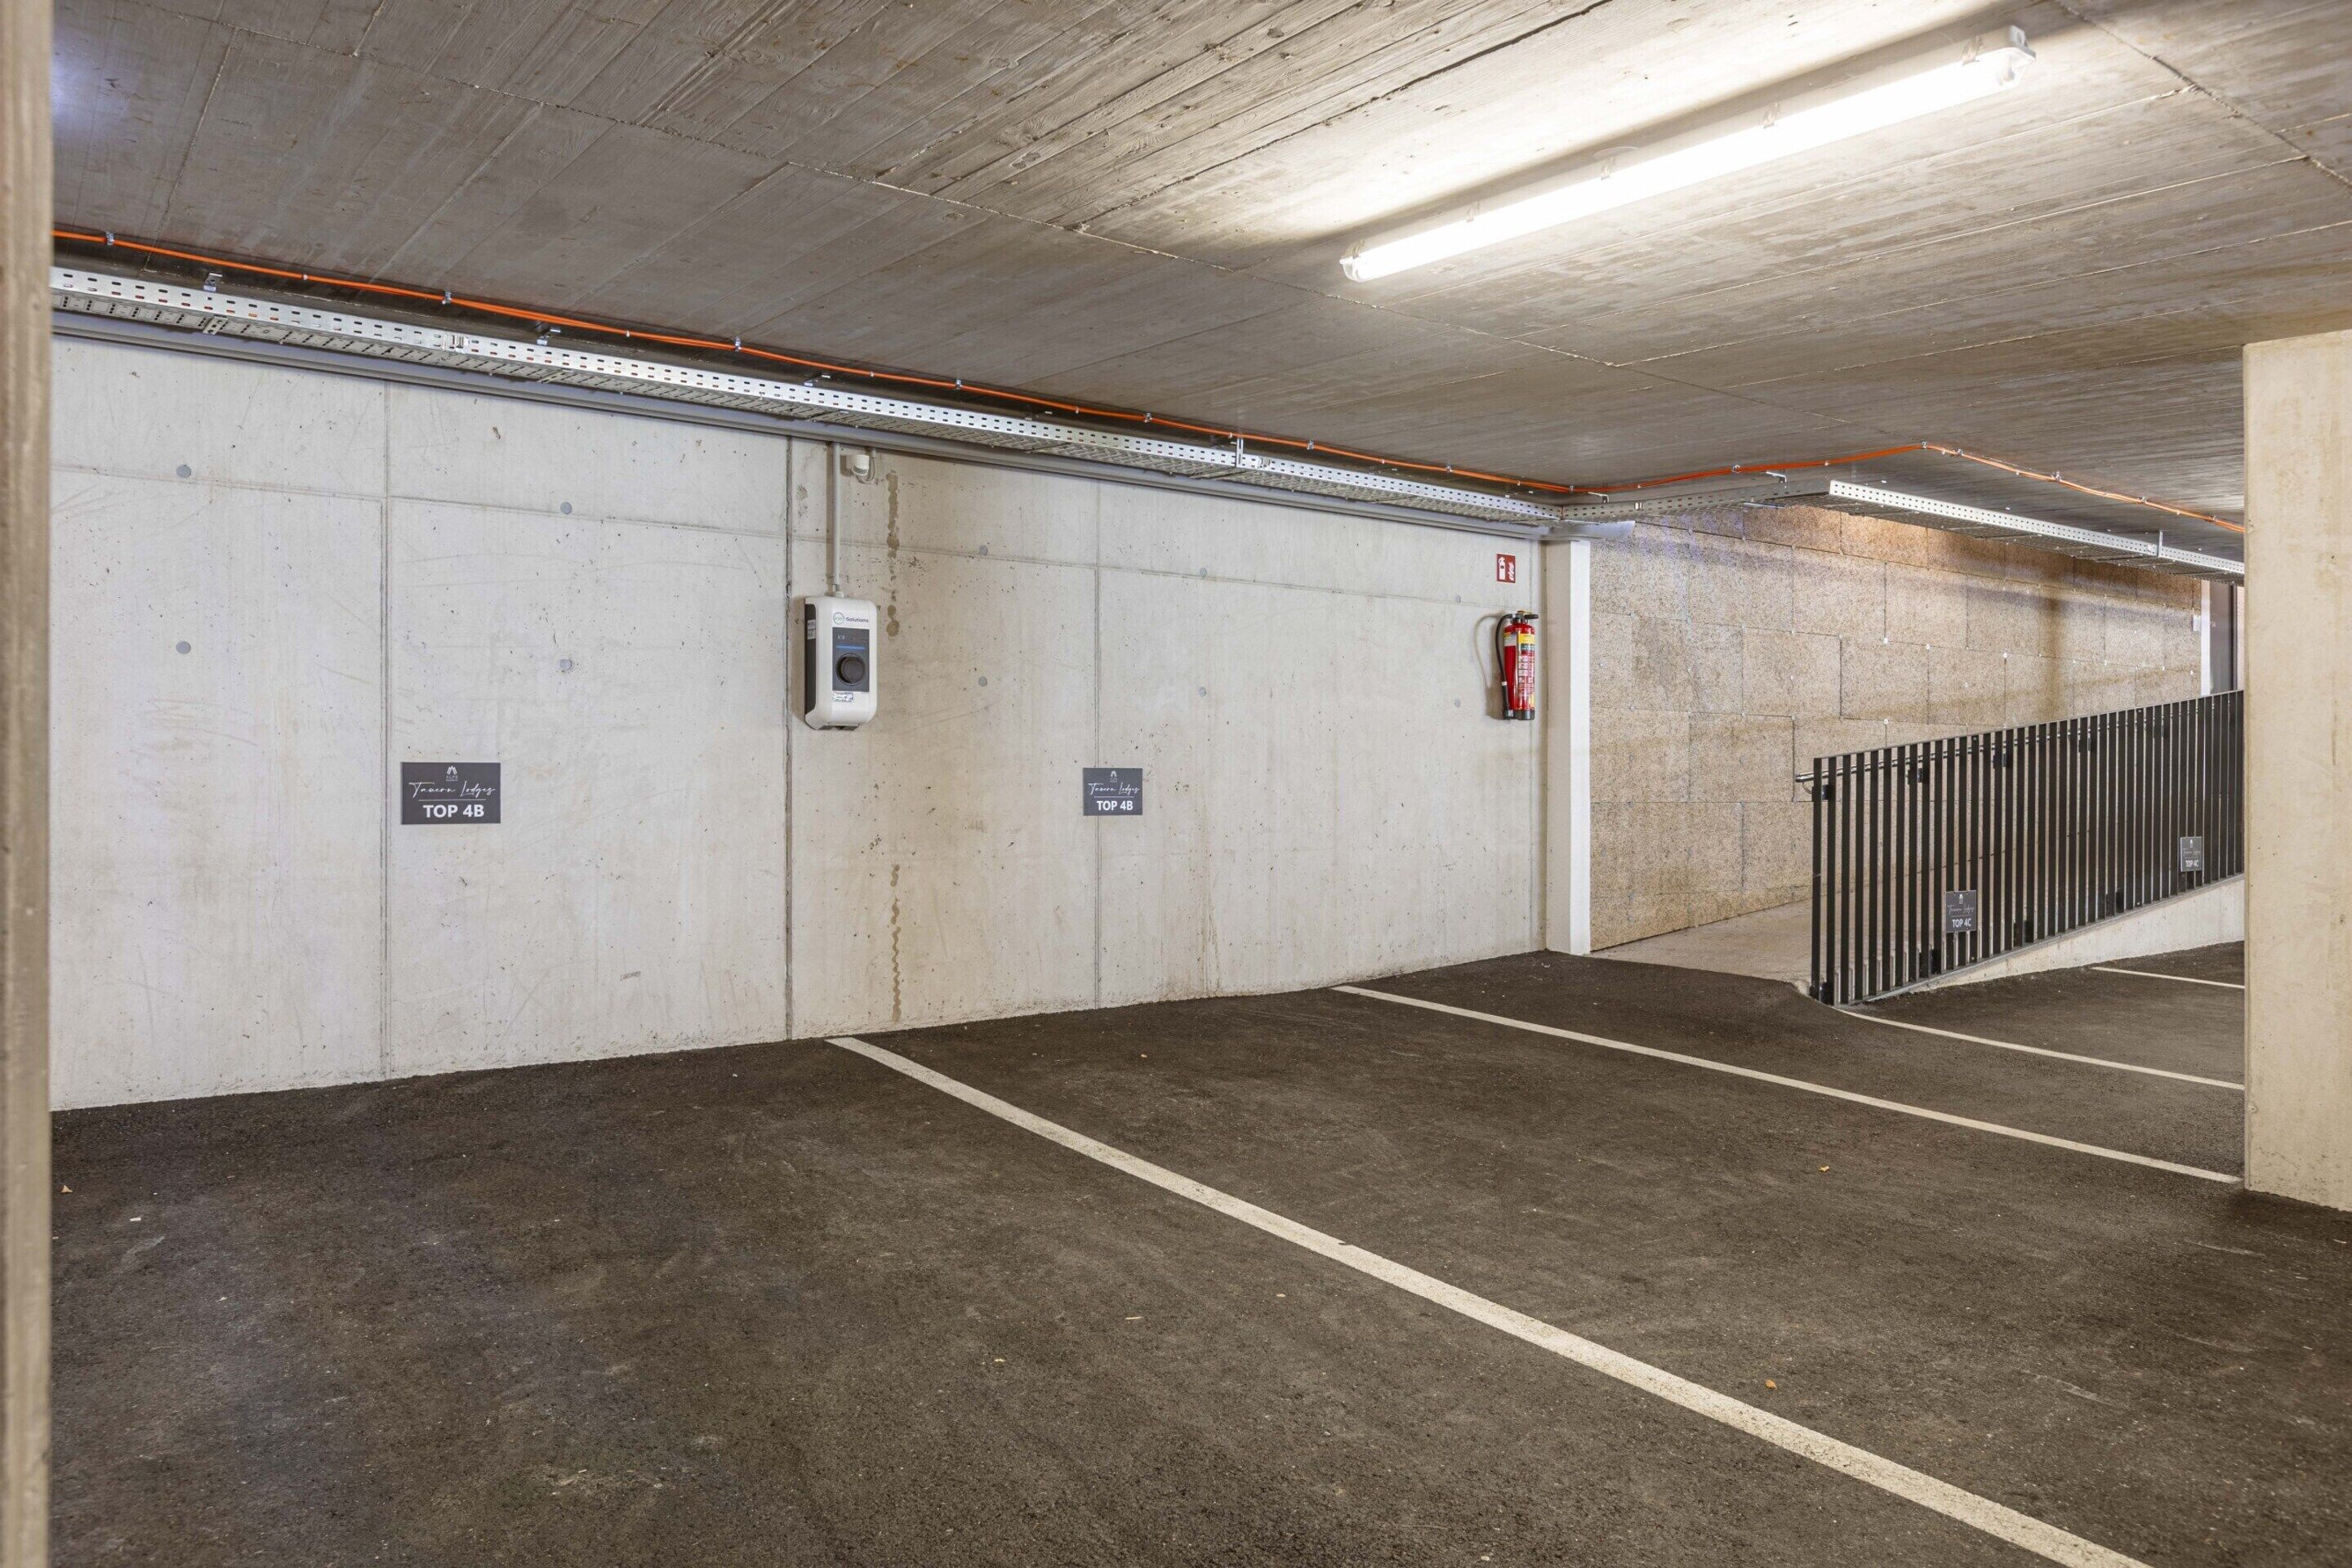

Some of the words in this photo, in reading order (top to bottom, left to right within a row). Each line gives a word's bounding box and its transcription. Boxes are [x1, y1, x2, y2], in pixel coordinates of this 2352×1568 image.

[408, 782, 456, 798] Tauern
[460, 781, 496, 798] Lodges
[423, 804, 457, 817] TOP
[462, 804, 484, 817] 4B
[1097, 800, 1117, 811] TOP
[1120, 800, 1134, 811] 4B
[1952, 919, 1963, 927] TOP
[1964, 918, 1971, 926] 4C
